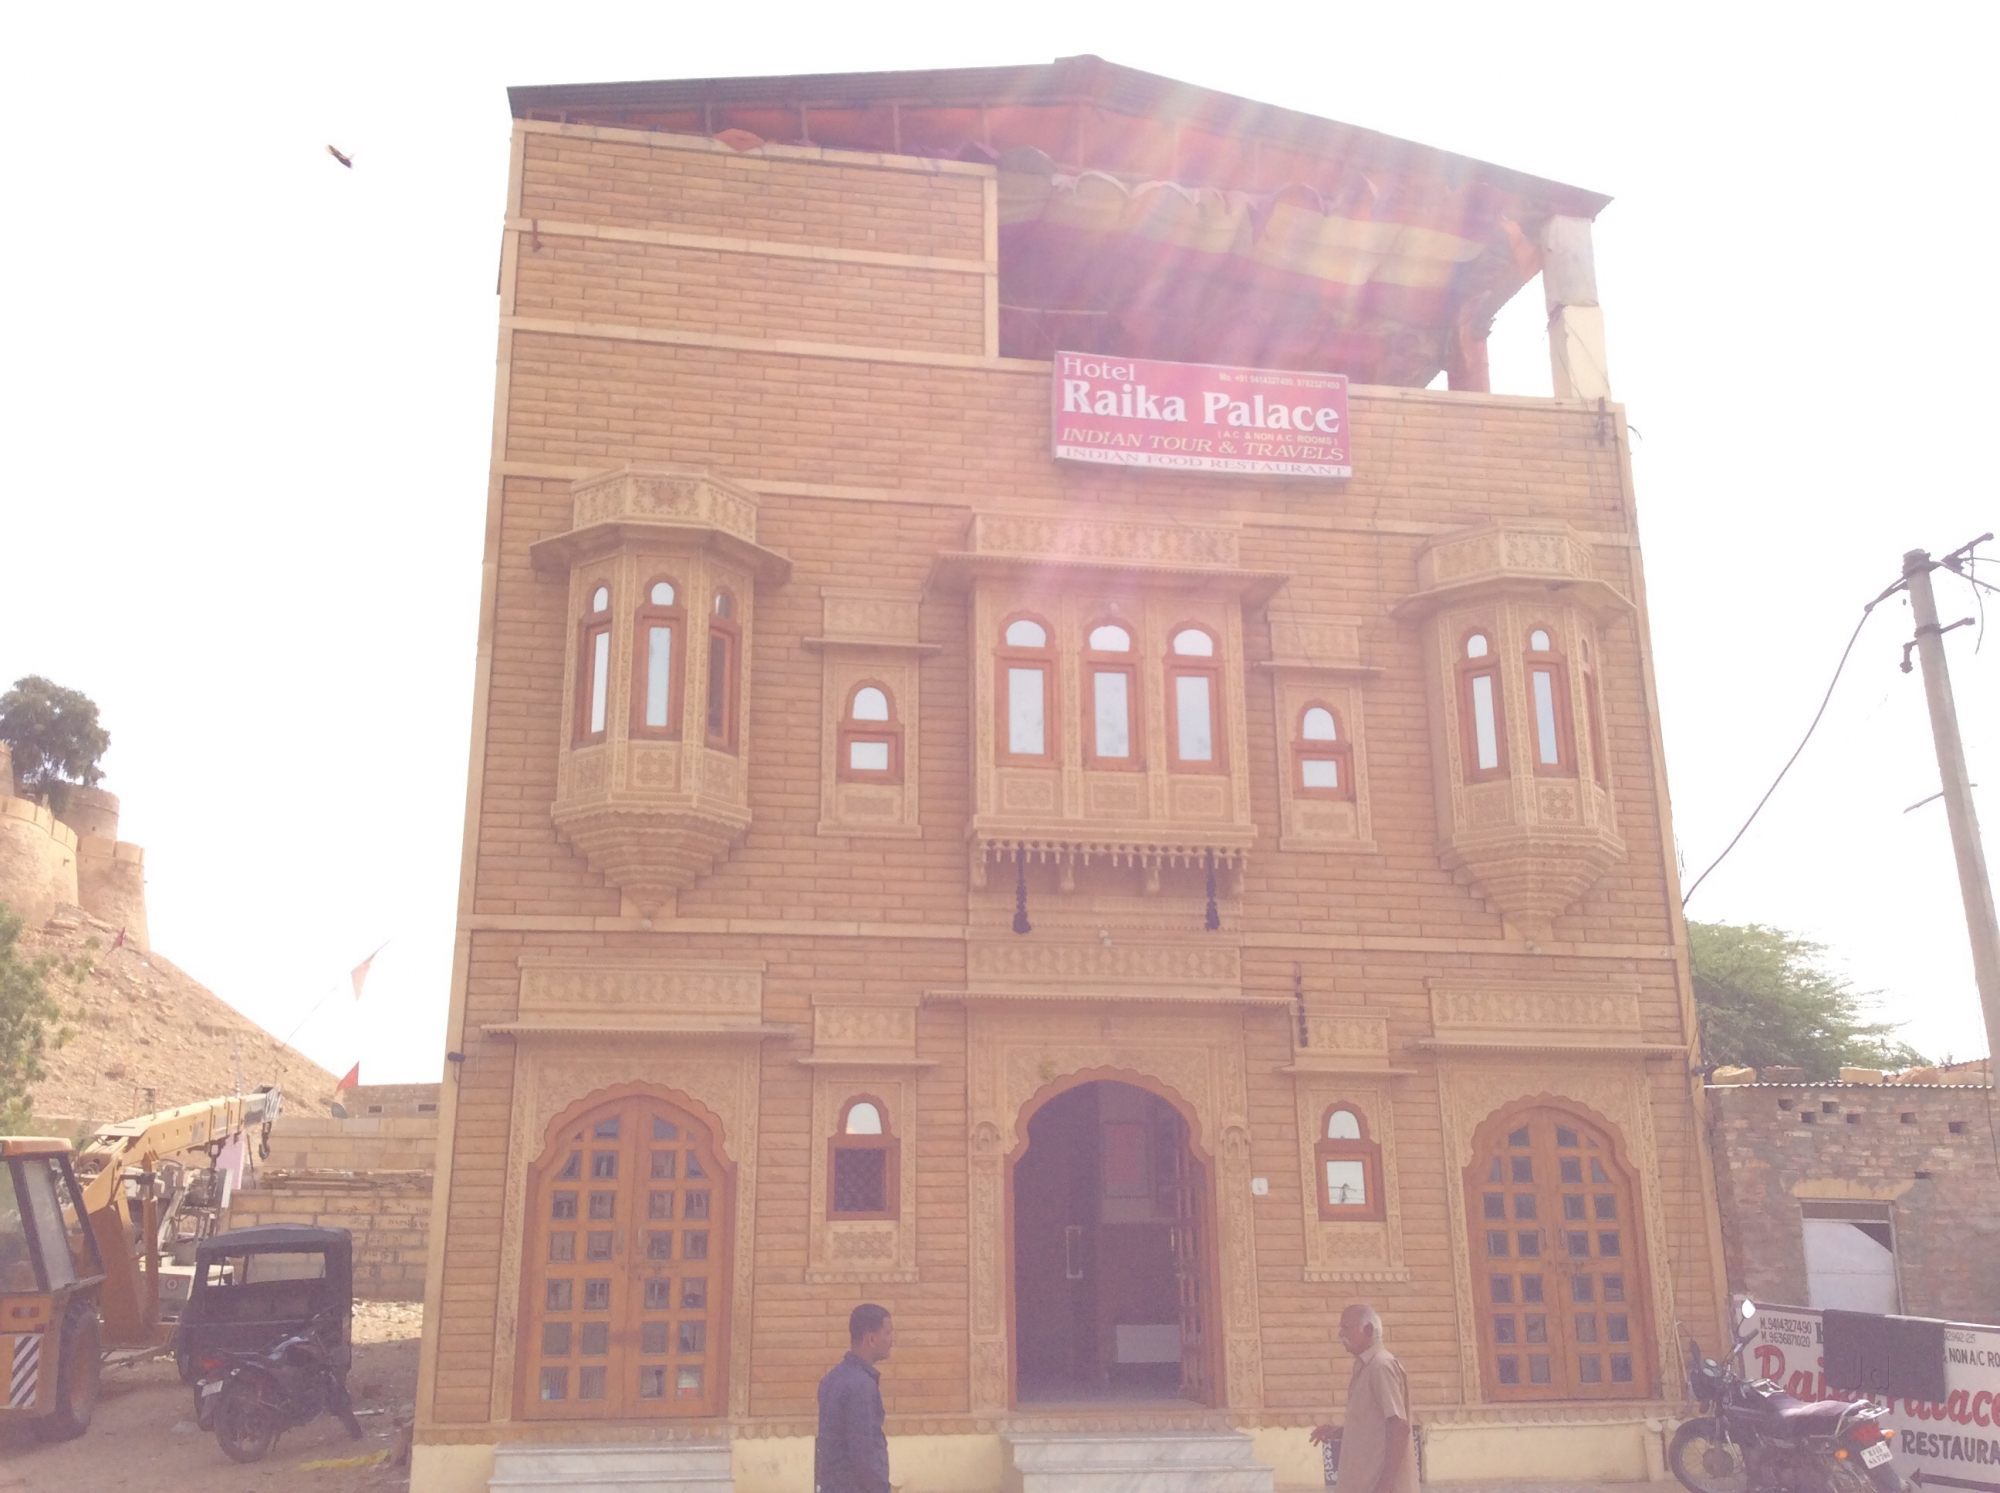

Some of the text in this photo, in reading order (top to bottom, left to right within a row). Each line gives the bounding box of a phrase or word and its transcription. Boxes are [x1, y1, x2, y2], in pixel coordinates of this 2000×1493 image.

[1063, 357, 1136, 382] Hotel
[1062, 379, 1340, 433] Raika Palace
[1061, 428, 1345, 461] INDIAN TOUR & TRAVELS
[1253, 432, 1274, 442] NON
[1065, 447, 1346, 477] INDIAN FOOD RESTAURANT
[1948, 1347, 1968, 1365] NON
